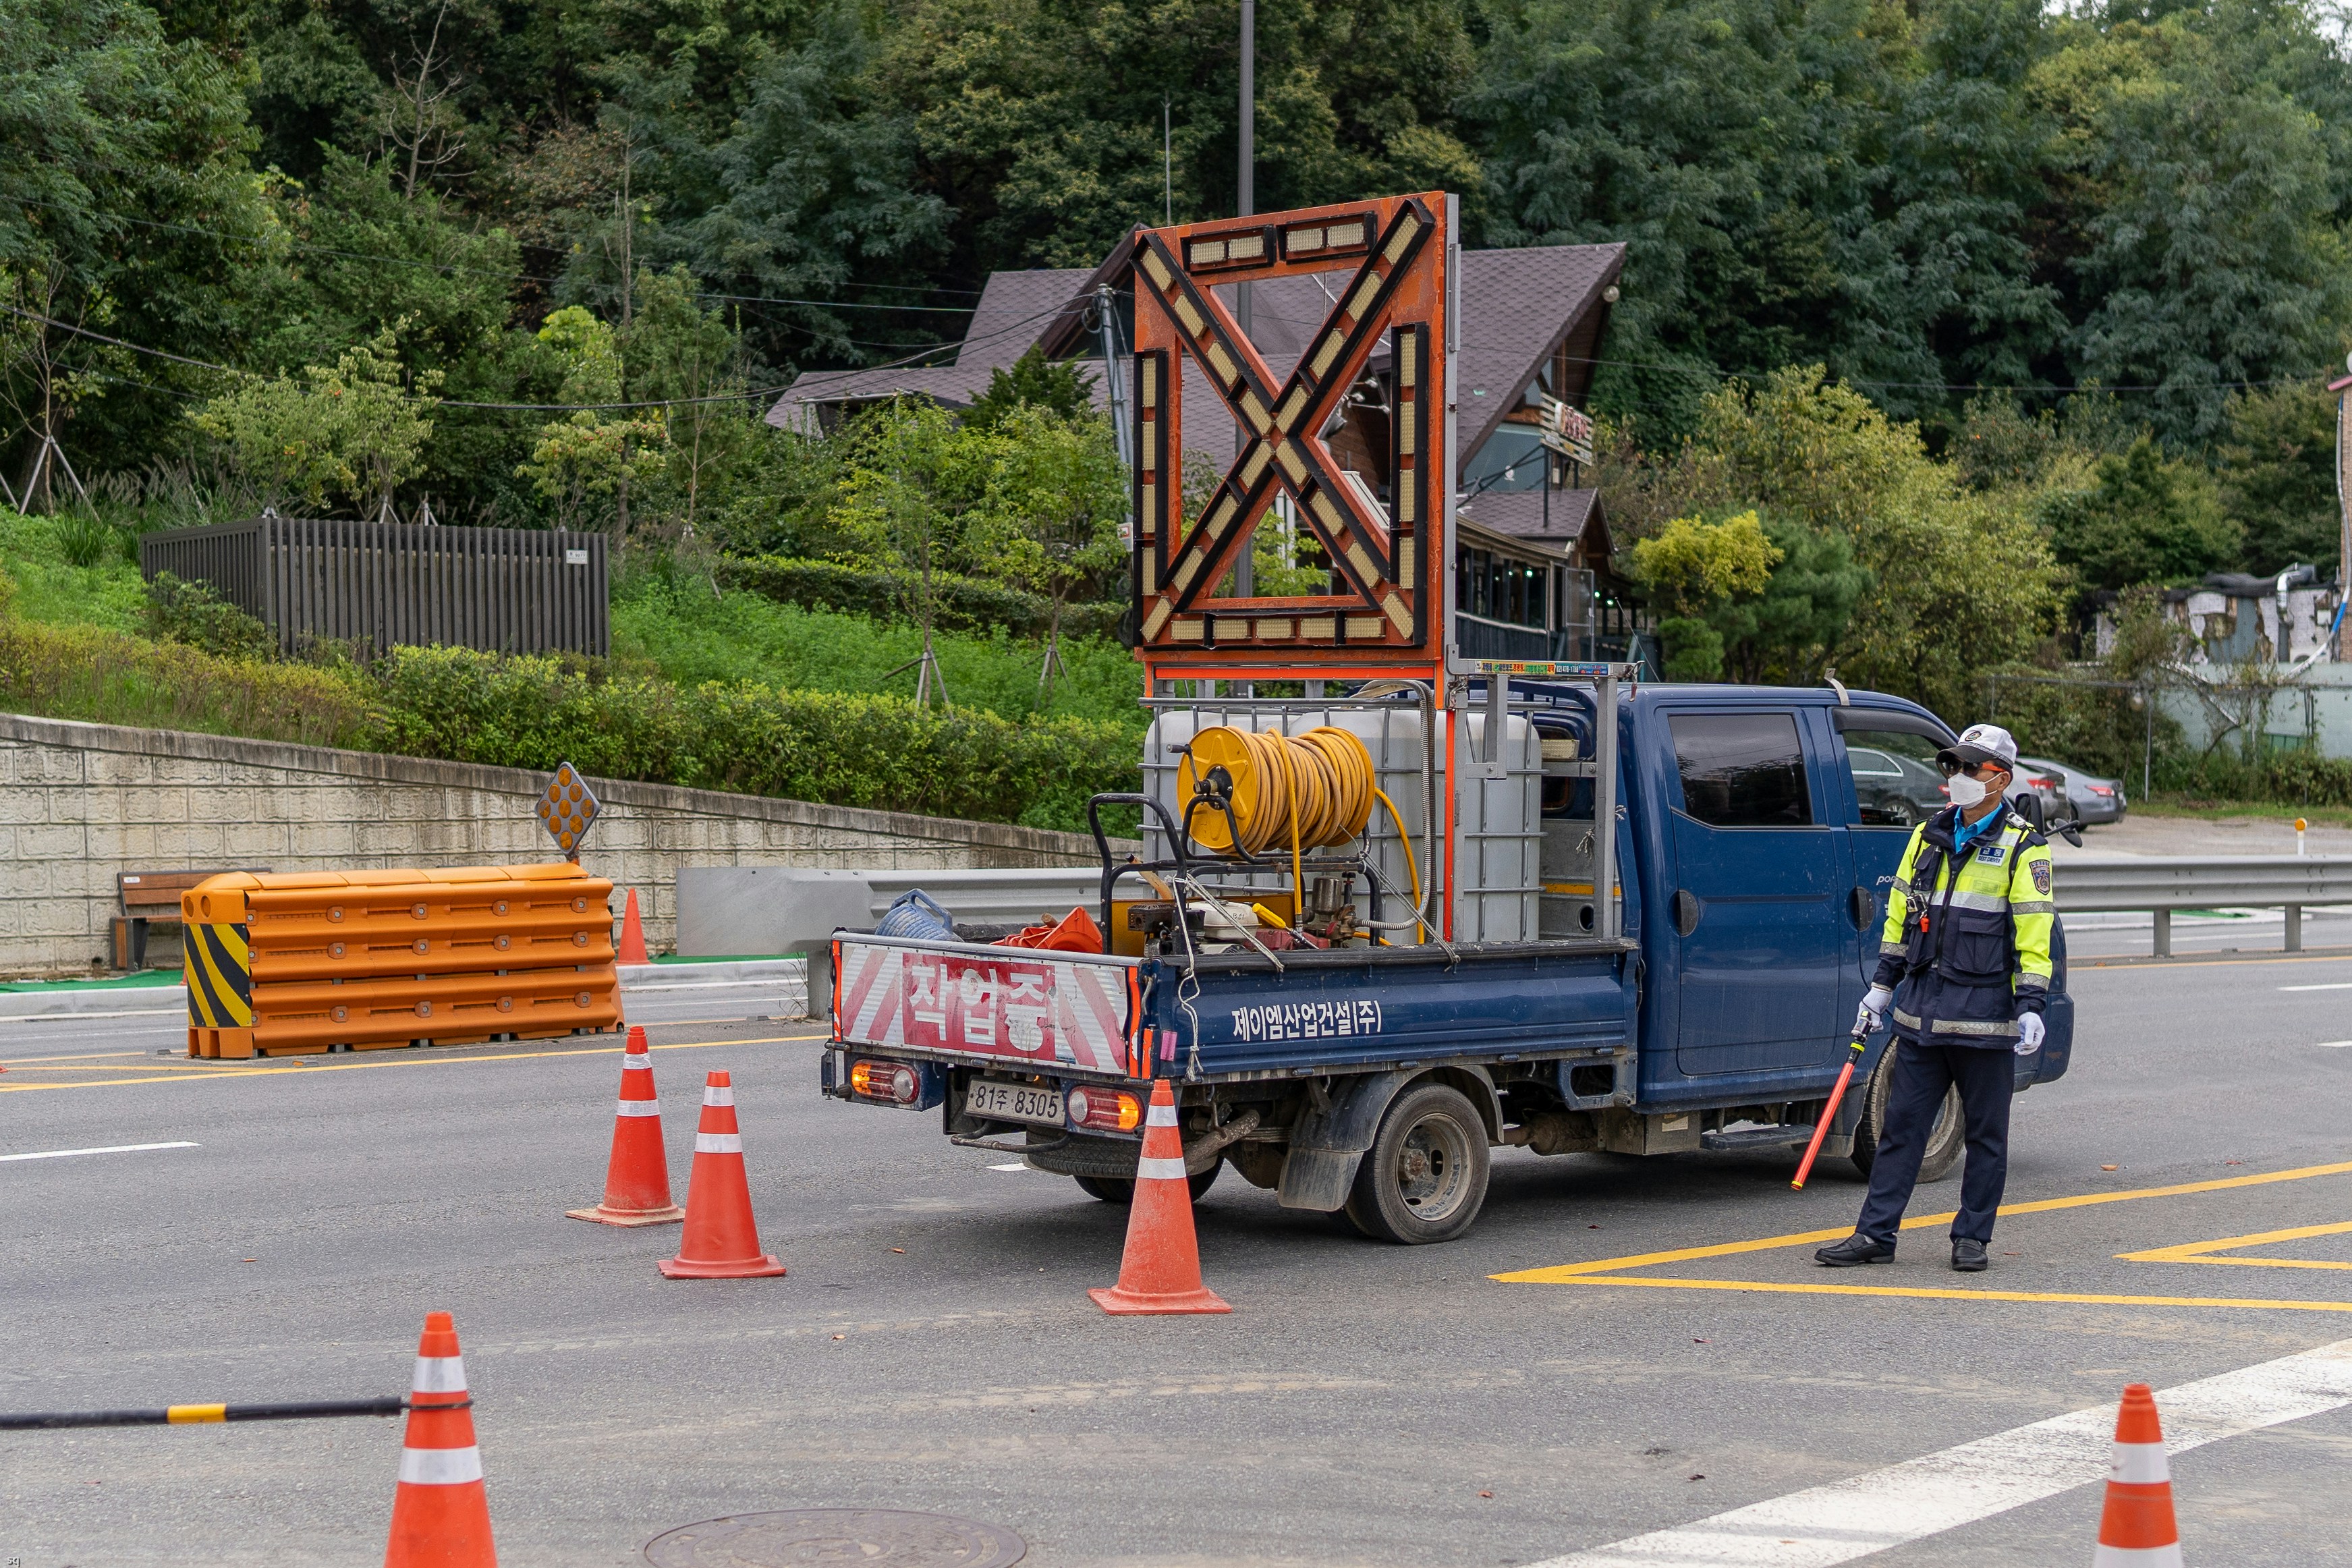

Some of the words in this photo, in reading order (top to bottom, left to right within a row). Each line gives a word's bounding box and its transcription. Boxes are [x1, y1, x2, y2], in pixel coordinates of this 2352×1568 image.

[909, 963, 1047, 1052] 작업중
[1231, 1000, 1382, 1041] 제이엠산업건설(주)
[975, 1085, 1008, 1111] 81주
[1014, 1090, 1059, 1119] 8305
